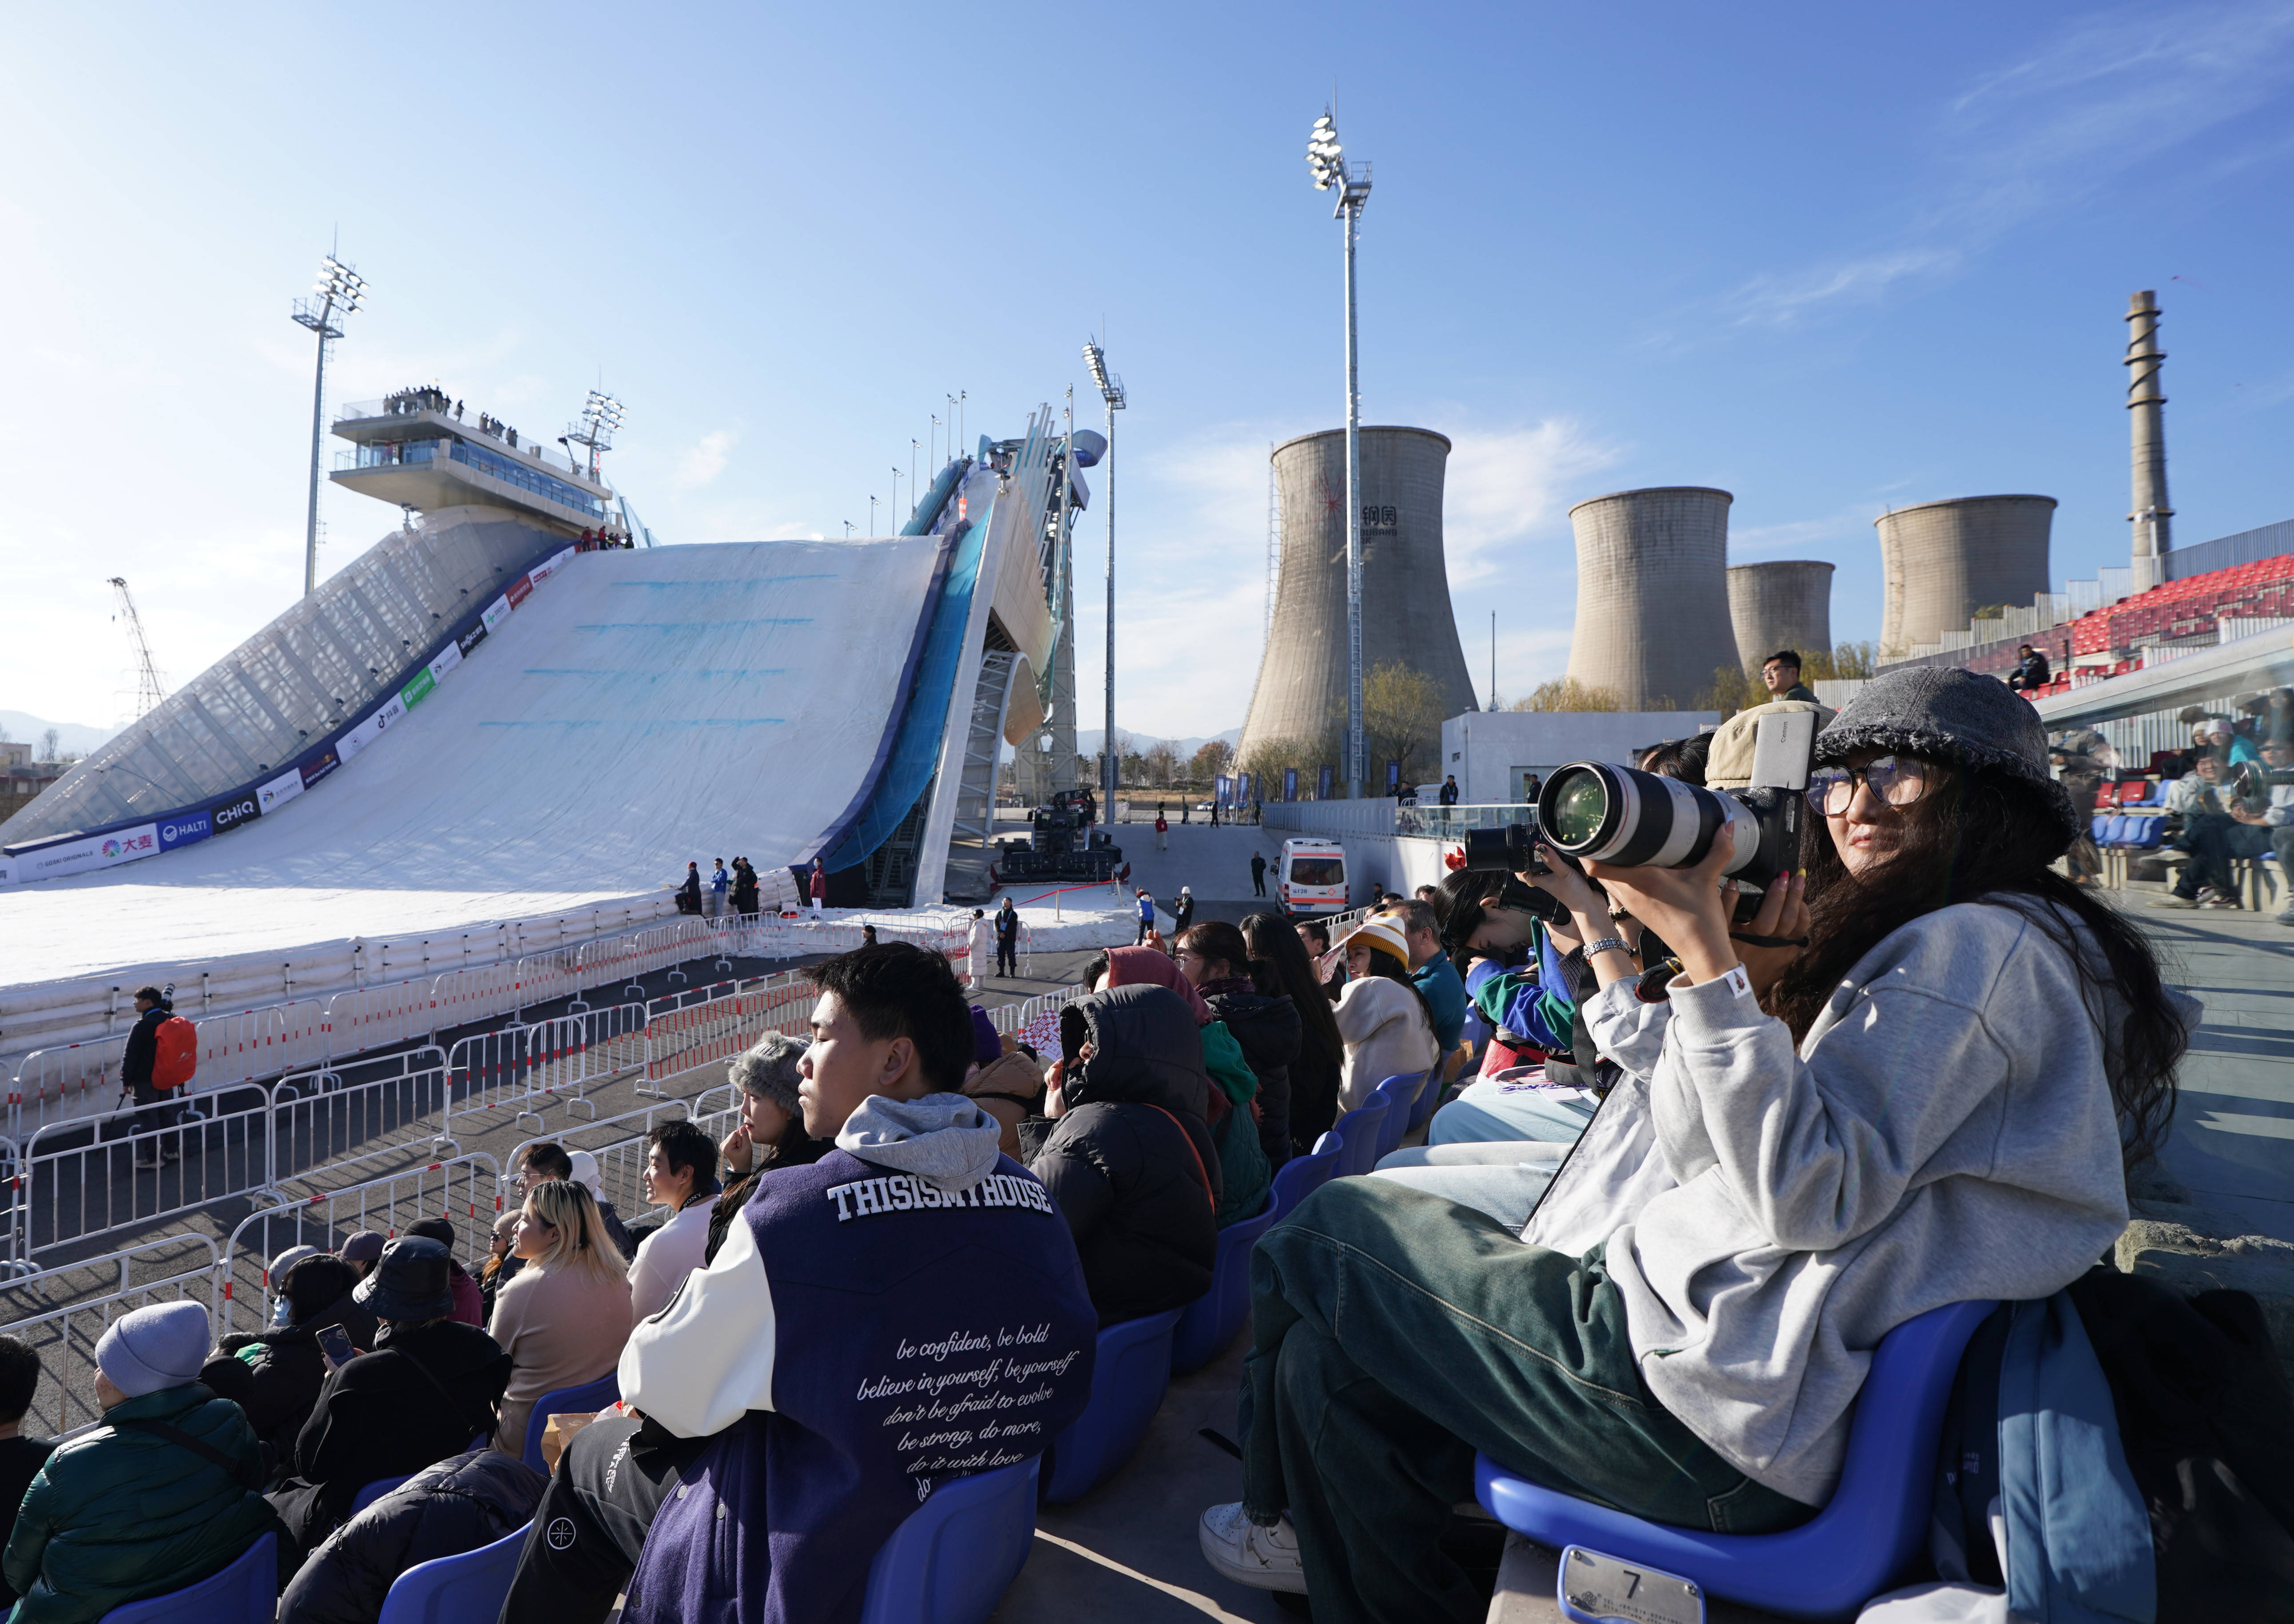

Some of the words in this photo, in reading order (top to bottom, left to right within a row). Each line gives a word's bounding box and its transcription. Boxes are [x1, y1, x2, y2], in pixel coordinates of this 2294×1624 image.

[216, 800, 255, 825] CHiQ
[179, 820, 207, 836] HALTI
[63, 851, 93, 863] ORIGINALS
[122, 834, 153, 854] 大麦
[683, 1192, 702, 1207] SONY
[897, 1338, 917, 1359] be
[919, 1330, 991, 1362] confident,
[997, 1327, 1014, 1347] be
[1016, 1323, 1050, 1344] bold
[857, 1375, 916, 1401] believe
[917, 1372, 936, 1390] in
[929, 1358, 1003, 1396] yourself,
[1004, 1358, 1022, 1378] be
[1017, 1350, 1080, 1383] yourself
[928, 1399, 949, 1419] be
[945, 1390, 1000, 1422] afraid
[997, 1395, 1016, 1409] to
[1017, 1382, 1054, 1406] evolve
[897, 1431, 919, 1451] be
[919, 1429, 973, 1449] strong,
[979, 1419, 1002, 1439] do
[1001, 1421, 1041, 1436] more,
[906, 1455, 929, 1474] do
[930, 1456, 947, 1469] it
[947, 1450, 989, 1468] with
[988, 1448, 1024, 1466] love
[1623, 1570, 1641, 1599] 7
